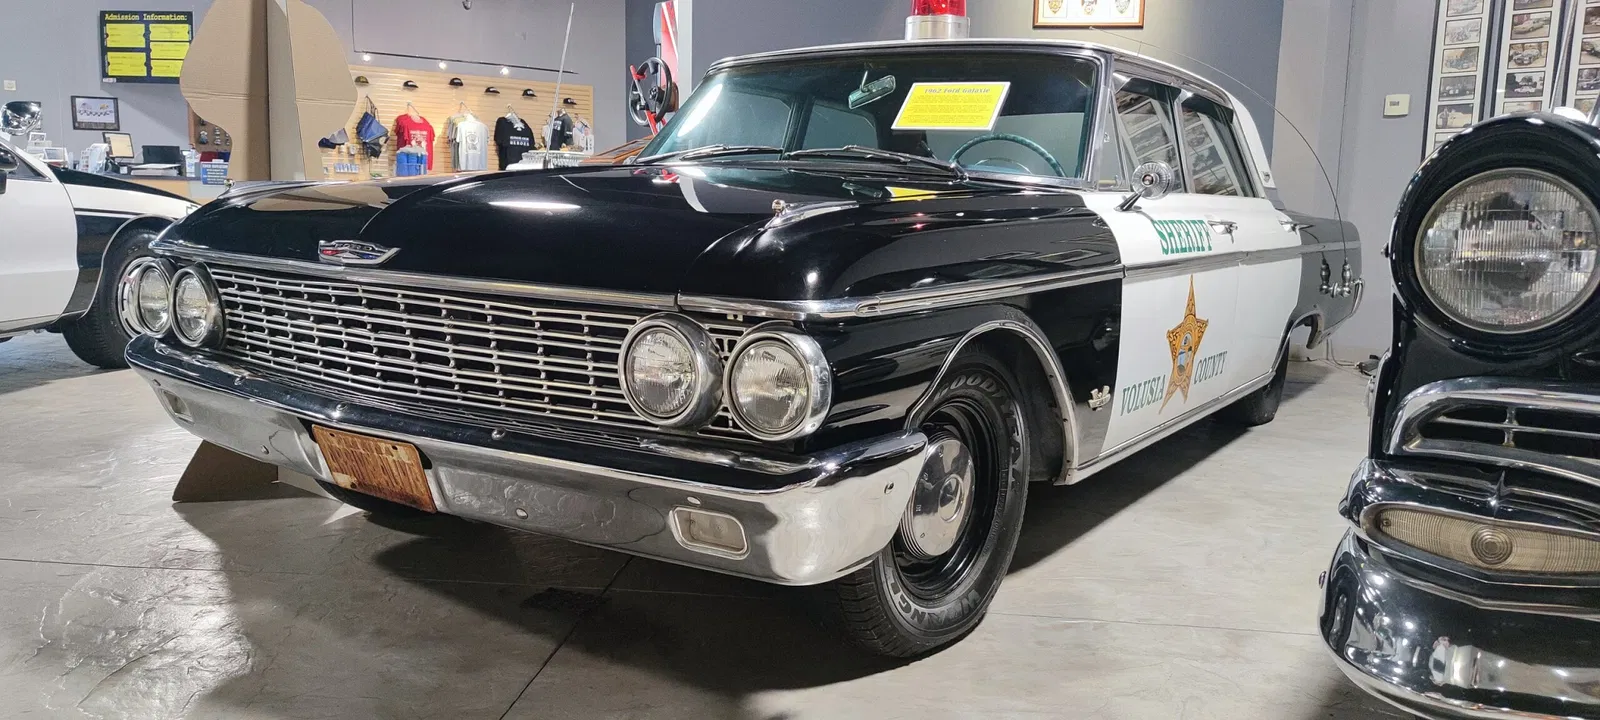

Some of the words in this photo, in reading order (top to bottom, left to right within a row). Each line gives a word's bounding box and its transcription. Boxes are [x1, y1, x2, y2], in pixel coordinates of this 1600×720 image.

[104, 13, 140, 21] Admission
[143, 13, 187, 21] Information:
[1151, 219, 1212, 255] SHERIFF
[1120, 374, 1166, 416] VOLUSIA
[1193, 350, 1228, 385] COUNTY
